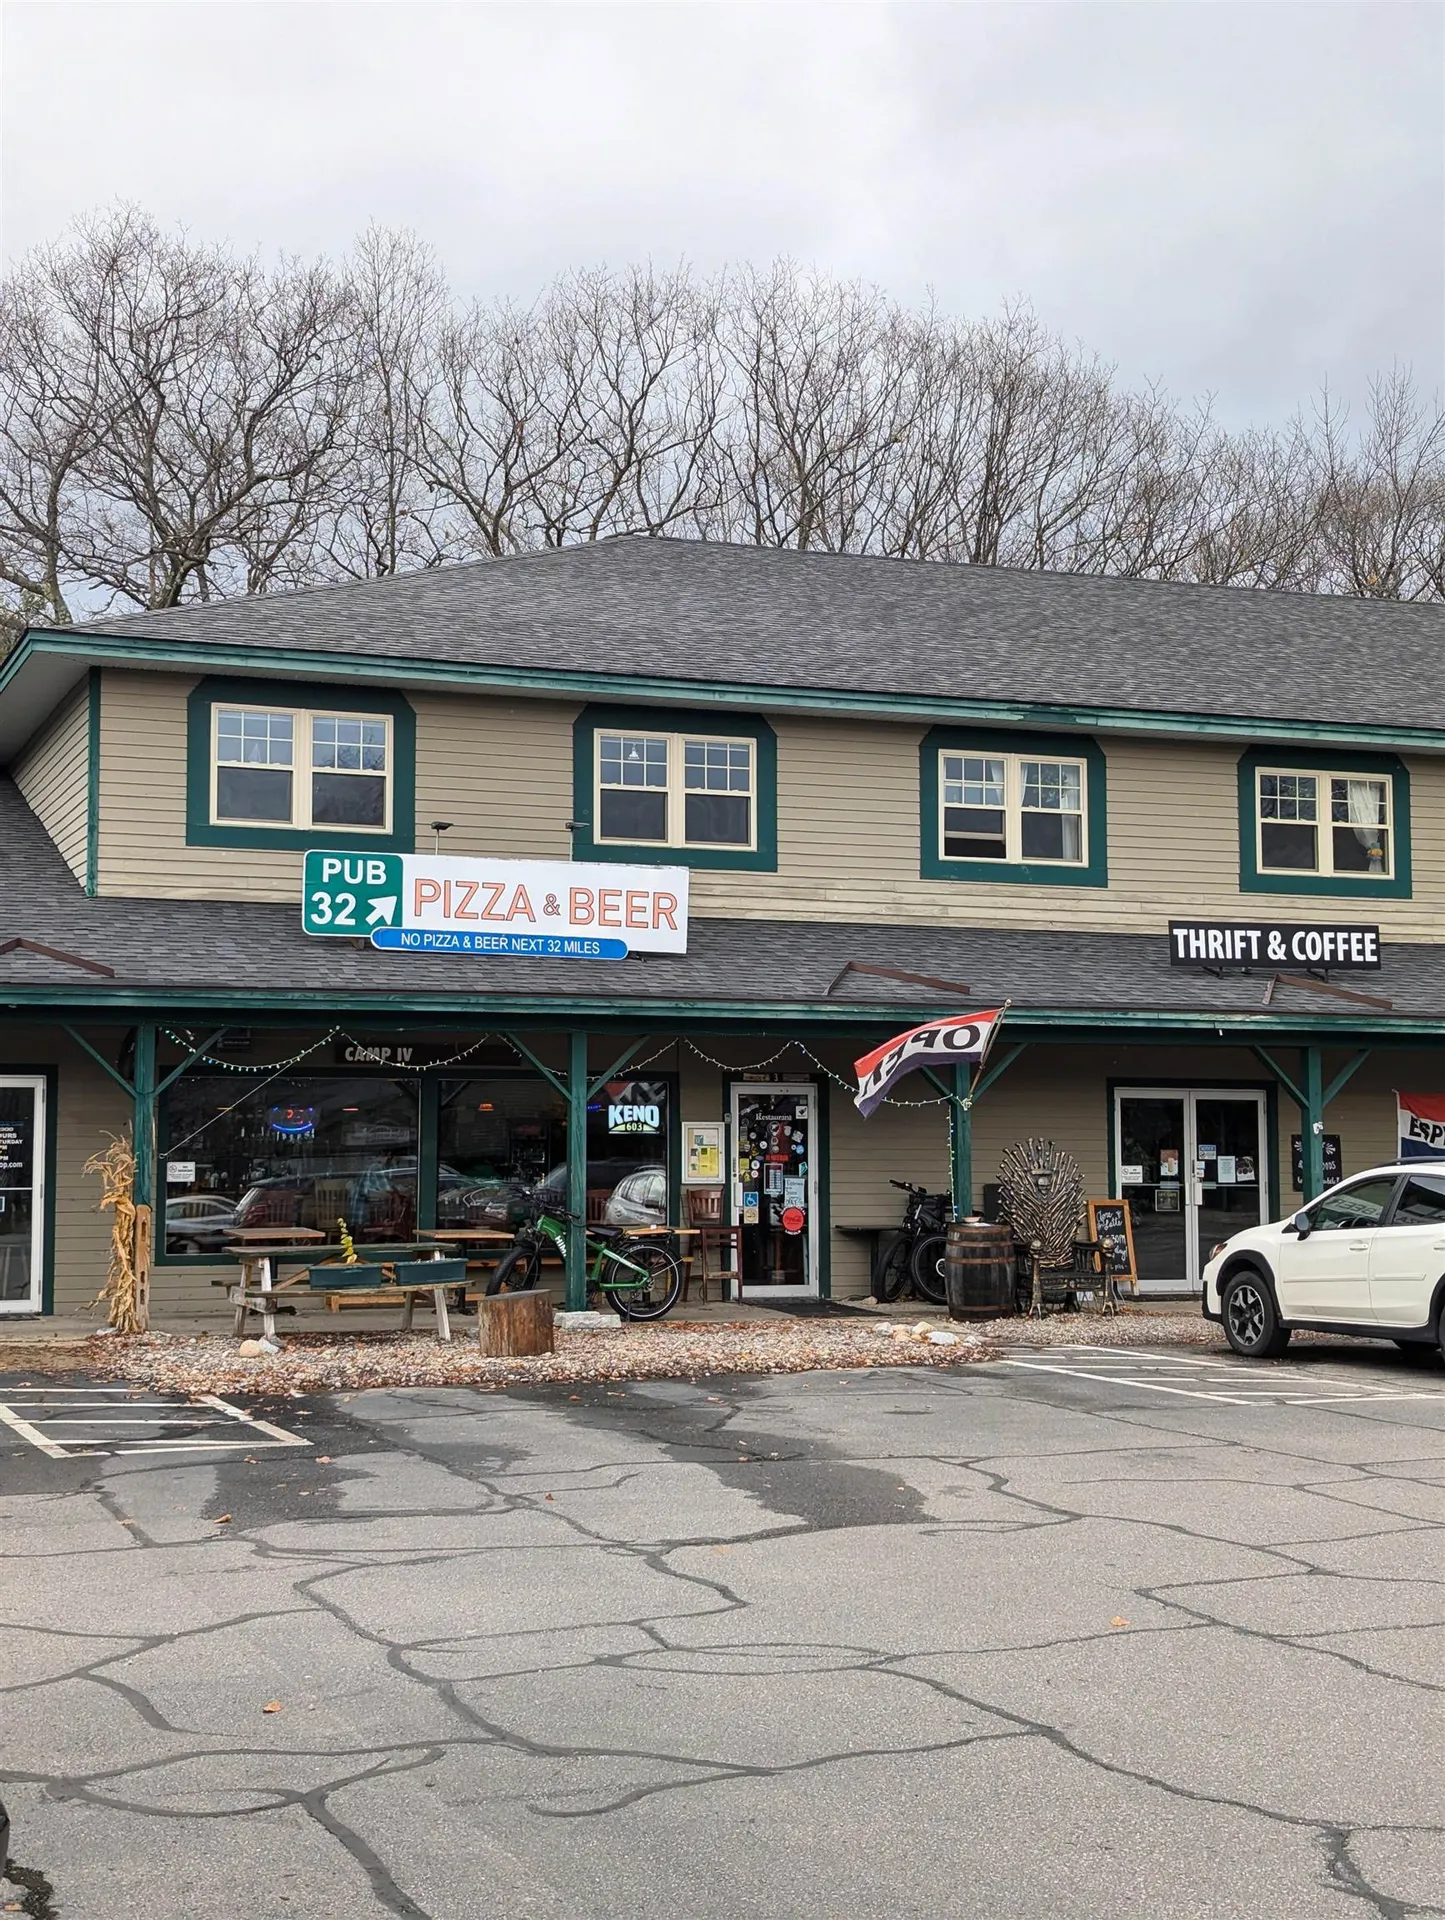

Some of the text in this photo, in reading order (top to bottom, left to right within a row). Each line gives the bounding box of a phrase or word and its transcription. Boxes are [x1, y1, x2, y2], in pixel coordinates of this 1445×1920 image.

[323, 858, 387, 885] PUB
[310, 891, 357, 926] 32
[414, 878, 678, 931] PIZZA & BEER
[401, 932, 600, 955] NO PIZZA & BEER NEXT 32 MILES
[1172, 928, 1379, 962] THRIFT & COFFEE
[345, 1047, 413, 1062] CAMP IV
[608, 1104, 660, 1129] KENO
[626, 1122, 643, 1131] 603
[1409, 1115, 1445, 1146] ESP
[555, 1235, 567, 1257] HIM
